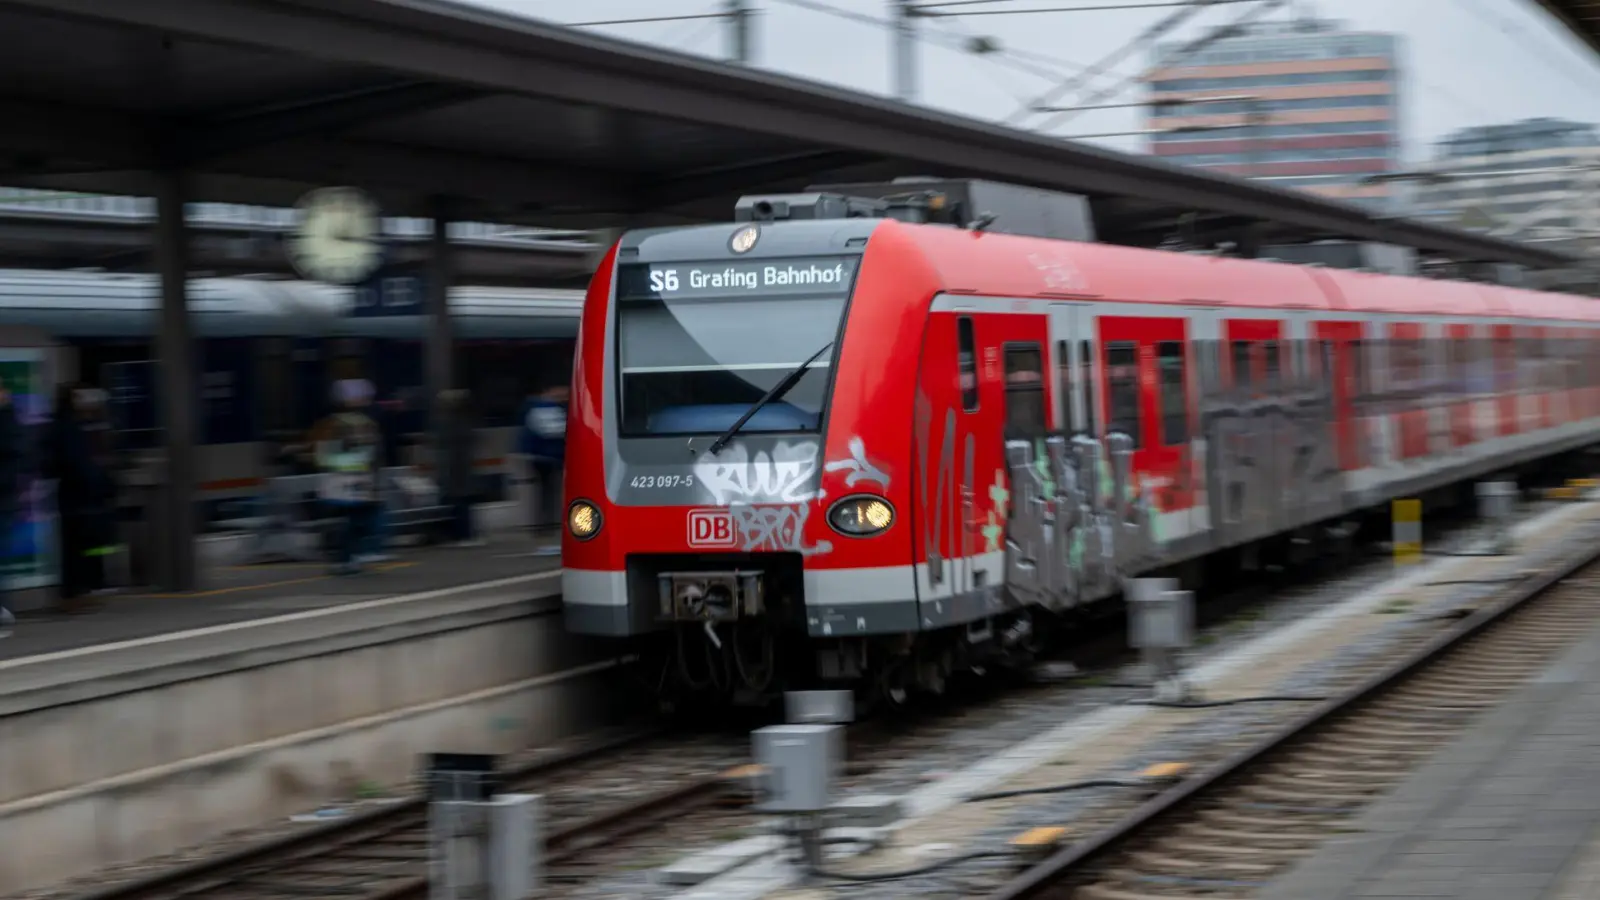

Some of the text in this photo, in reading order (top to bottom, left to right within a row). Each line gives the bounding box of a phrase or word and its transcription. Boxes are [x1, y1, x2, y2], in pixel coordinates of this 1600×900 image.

[649, 263, 843, 292] S6 Grafing Bahnhof
[630, 474, 693, 488] 423 097-5
[693, 515, 732, 542] DB
